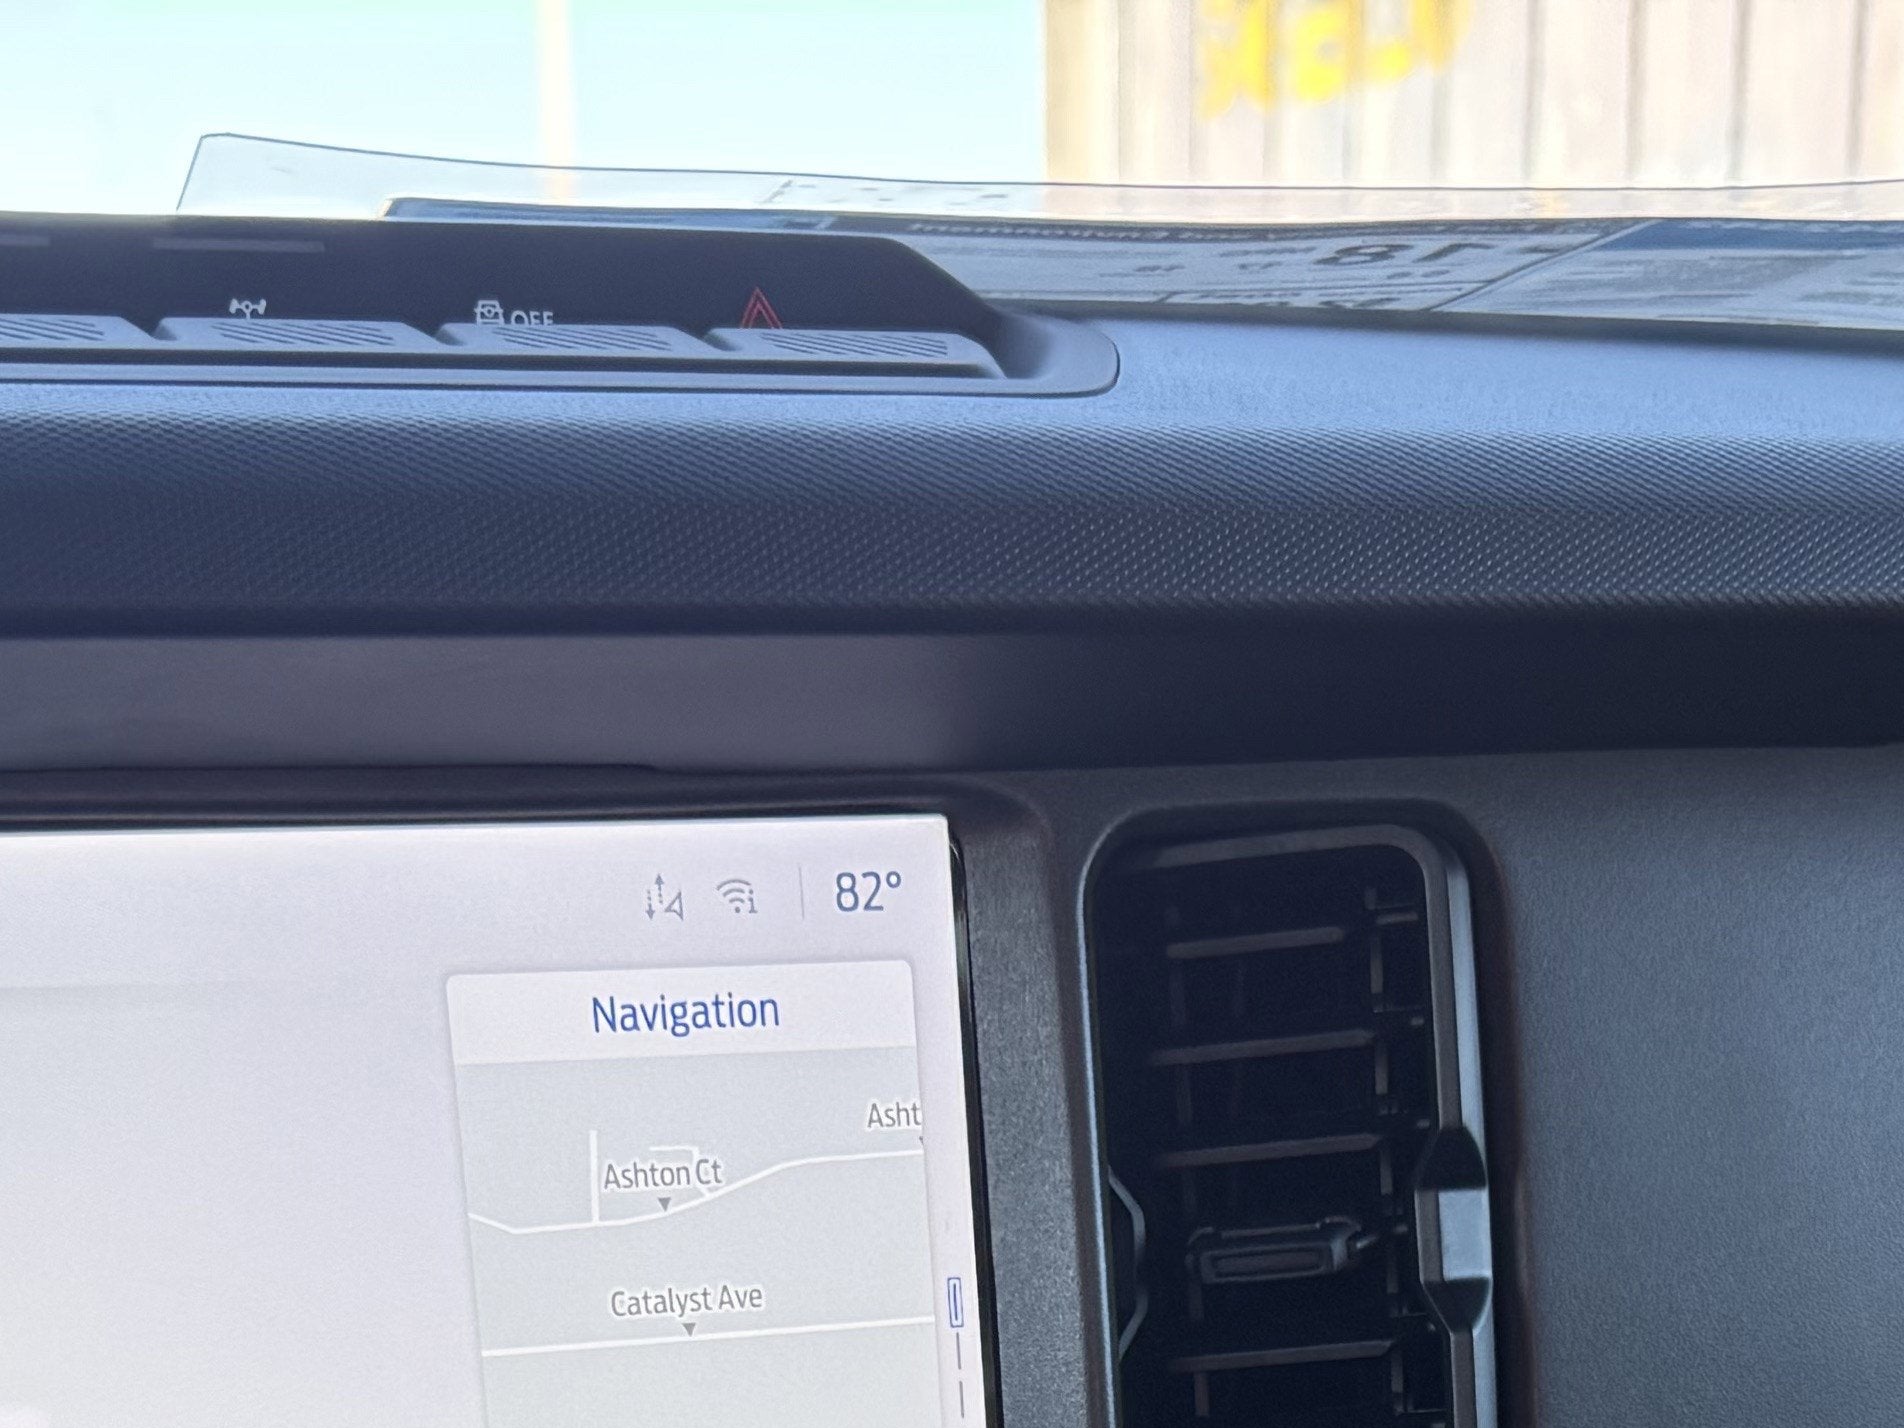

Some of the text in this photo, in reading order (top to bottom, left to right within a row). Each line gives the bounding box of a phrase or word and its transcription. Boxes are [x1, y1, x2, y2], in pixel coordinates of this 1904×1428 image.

[834, 870, 903, 914] 82°
[590, 992, 781, 1038] Navigation
[866, 1101, 923, 1130] Asht
[602, 1158, 724, 1190] Ashton Ct
[610, 1285, 764, 1319] Catalyst Ave
